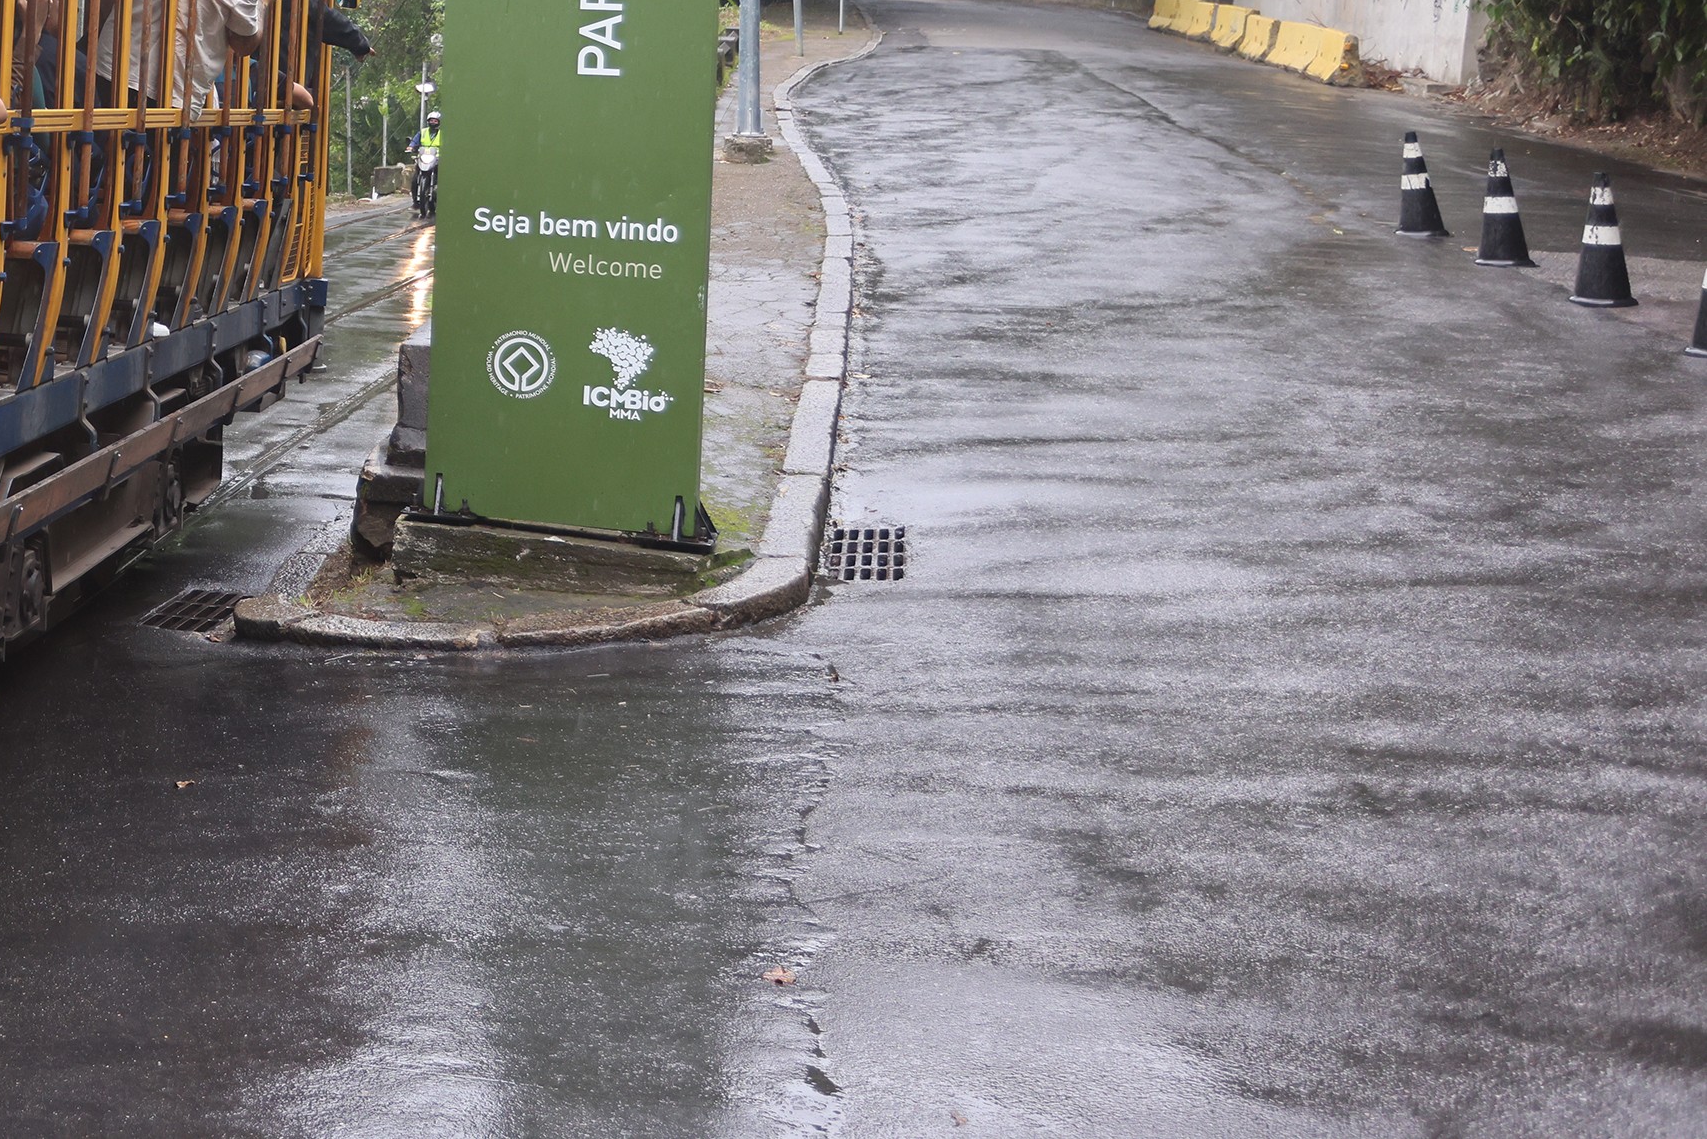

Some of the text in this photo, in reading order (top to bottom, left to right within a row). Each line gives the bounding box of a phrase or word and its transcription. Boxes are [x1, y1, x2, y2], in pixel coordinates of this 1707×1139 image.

[473, 207, 678, 243] Seja bem vindo
[548, 251, 663, 280] Welcome
[582, 384, 667, 412] ICMBio
[609, 408, 641, 421] MMA
